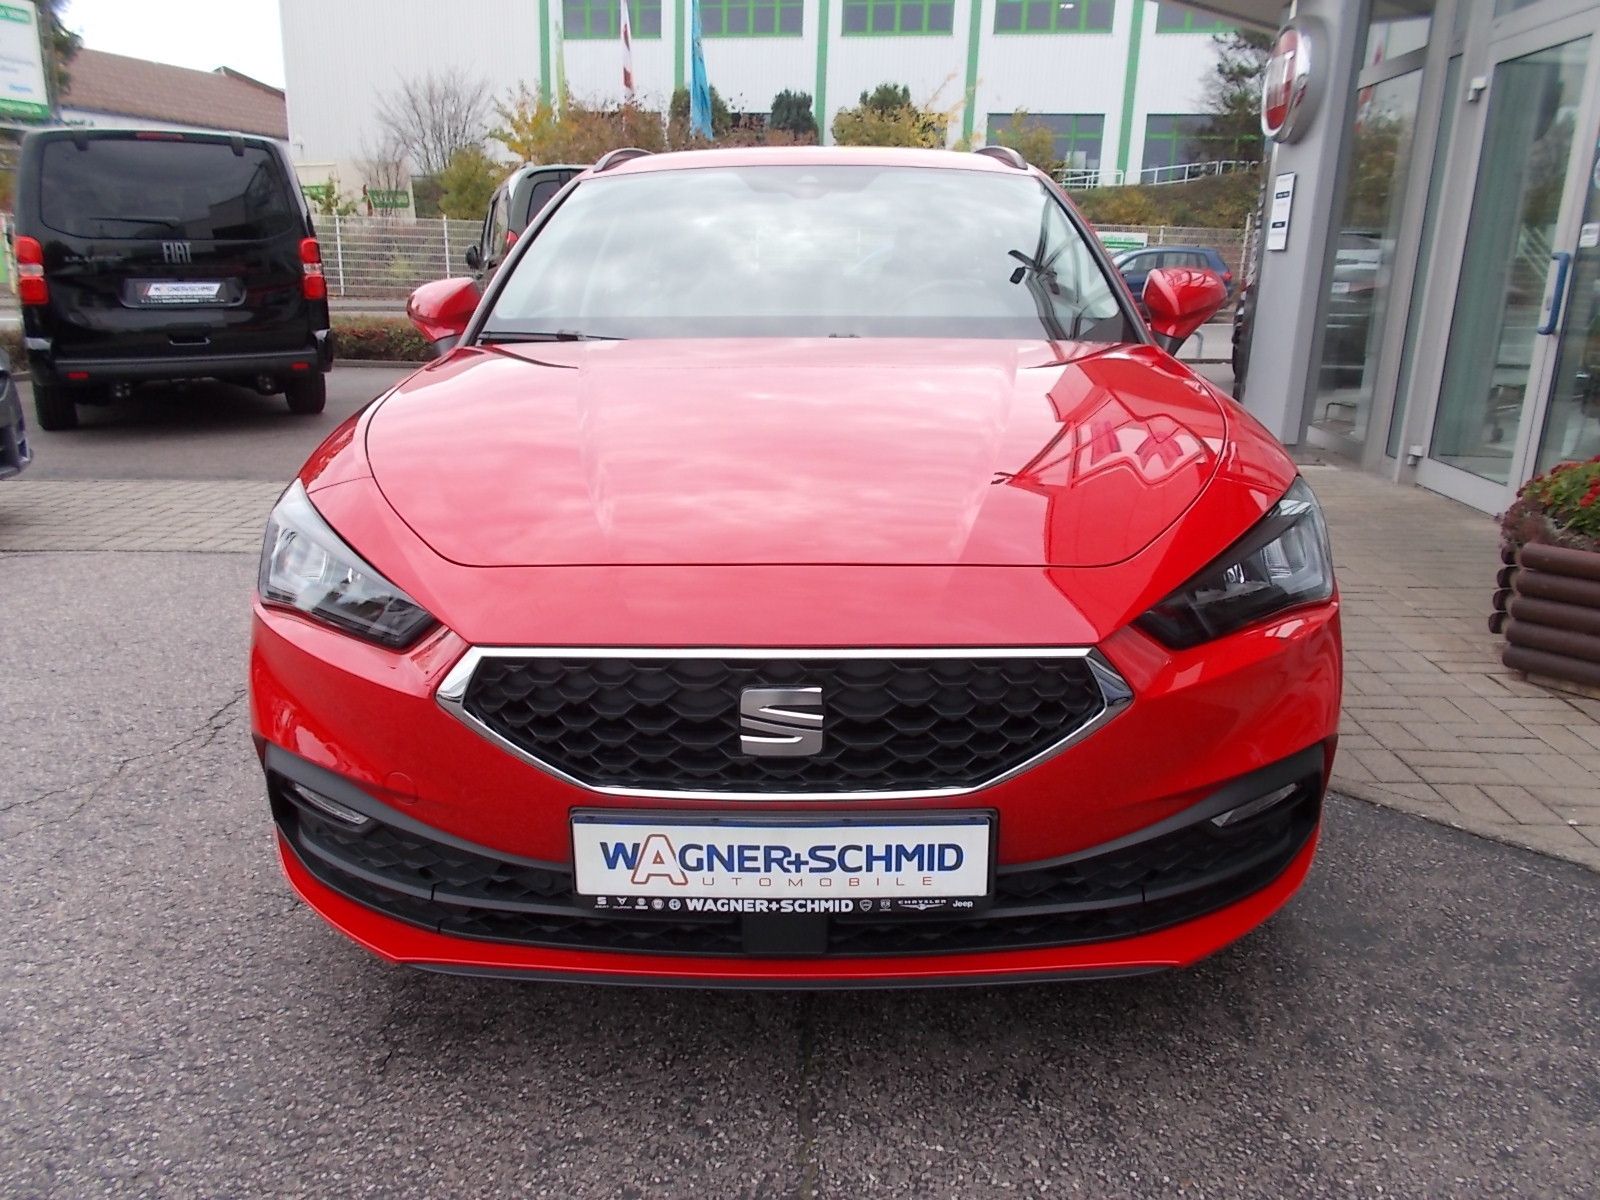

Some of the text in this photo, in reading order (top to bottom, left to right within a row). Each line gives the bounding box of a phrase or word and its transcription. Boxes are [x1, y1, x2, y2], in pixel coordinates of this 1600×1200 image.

[162, 242, 192, 264] FIAT
[686, 898, 854, 914] WAGNER+SCHMID
[952, 900, 974, 909] Jeep
